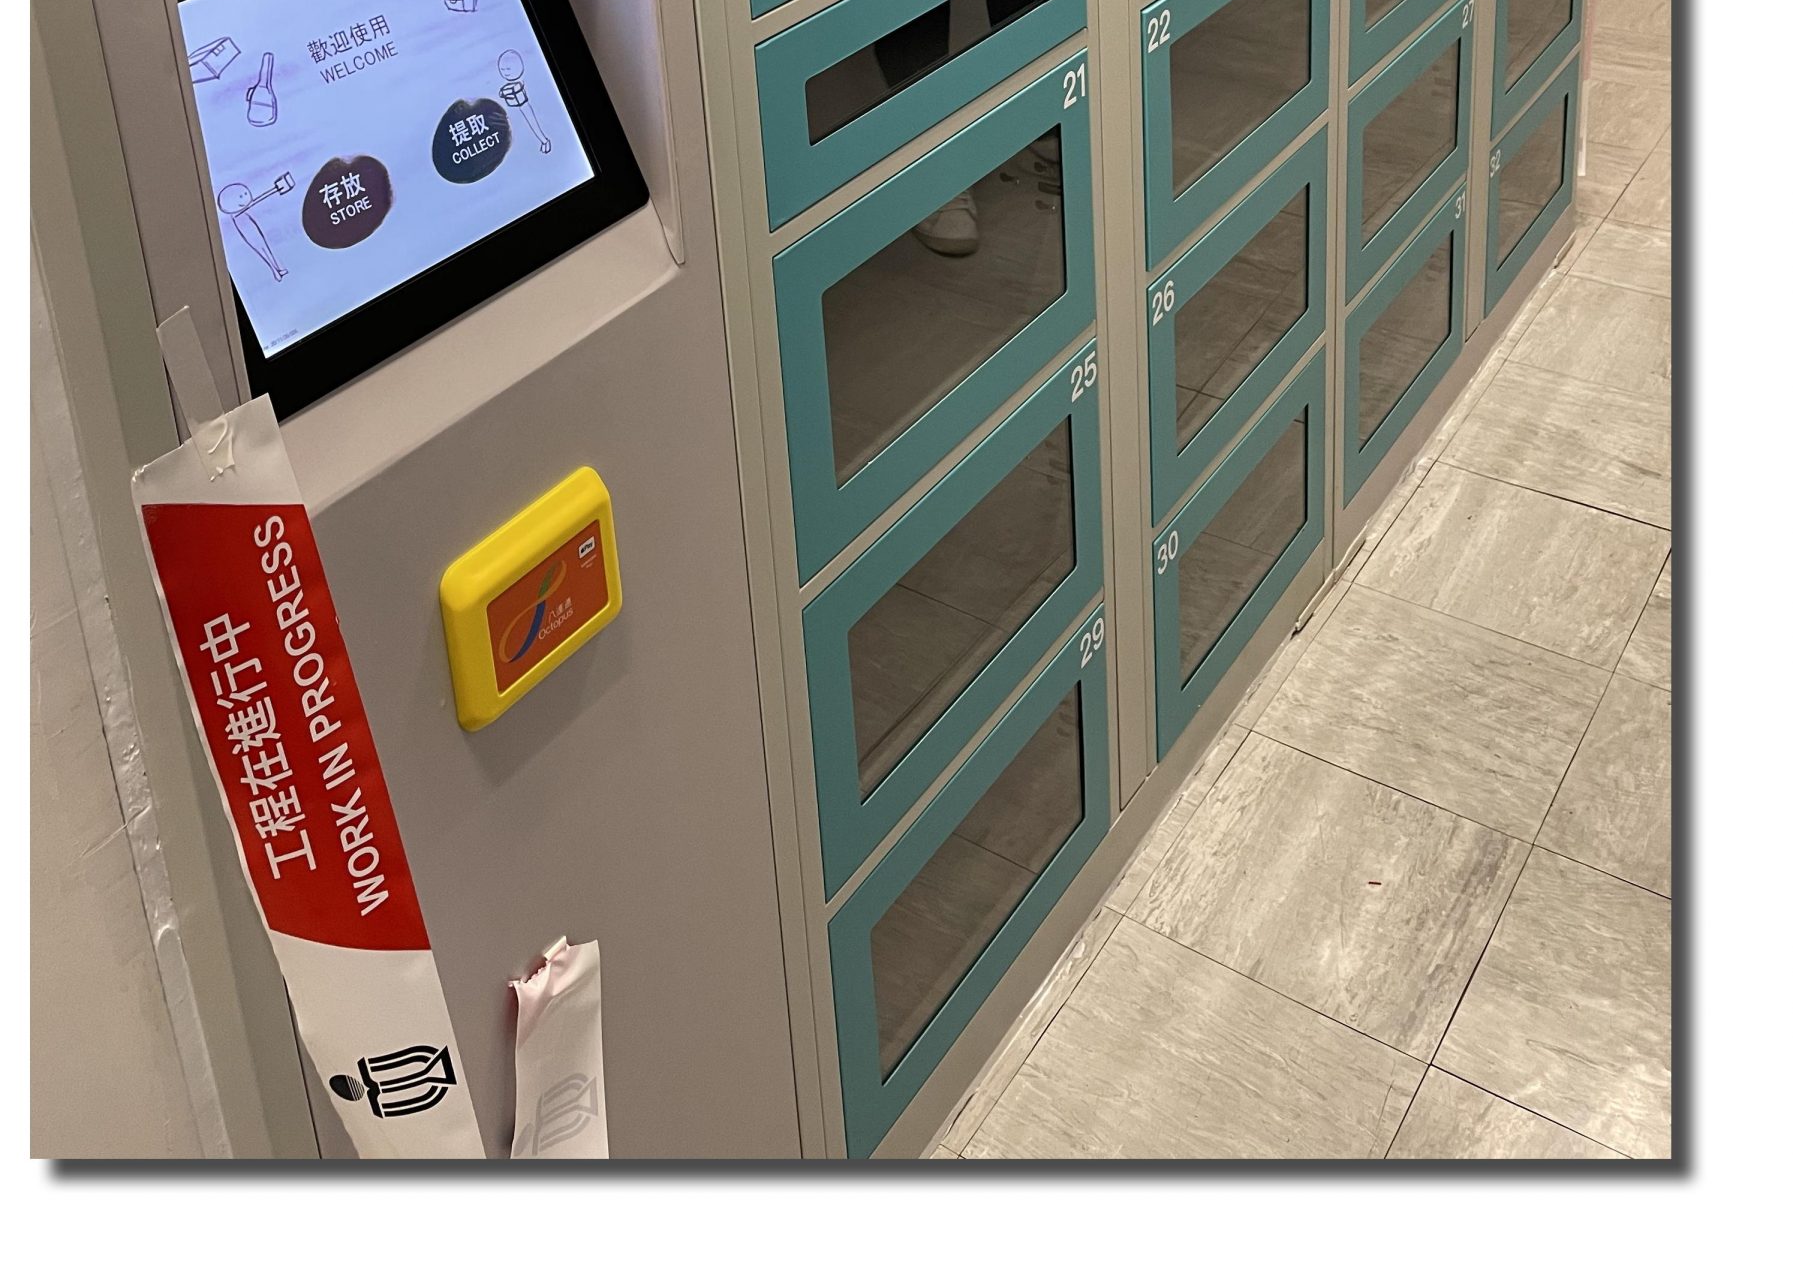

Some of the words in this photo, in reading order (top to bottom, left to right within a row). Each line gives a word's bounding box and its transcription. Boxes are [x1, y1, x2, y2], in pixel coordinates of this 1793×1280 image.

[307, 15, 390, 64] 歡迎使用
[1147, 9, 1171, 54] 22
[320, 41, 398, 84] WELCOME
[1063, 63, 1087, 110] 21
[449, 114, 489, 147] 提取
[452, 131, 500, 164] COLLECT
[319, 172, 366, 209] 存放
[330, 196, 372, 225] STORE
[1455, 190, 1466, 219] 31
[1151, 279, 1175, 326] 26
[1071, 350, 1097, 403] 25
[1156, 530, 1179, 576] 30
[253, 514, 342, 743] PROGRESS
[538, 608, 574, 640] Octopus
[1080, 617, 1105, 669] 29
[199, 612, 317, 880] 工程在進行中
[318, 741, 358, 791] IN
[331, 789, 390, 917] WORK
